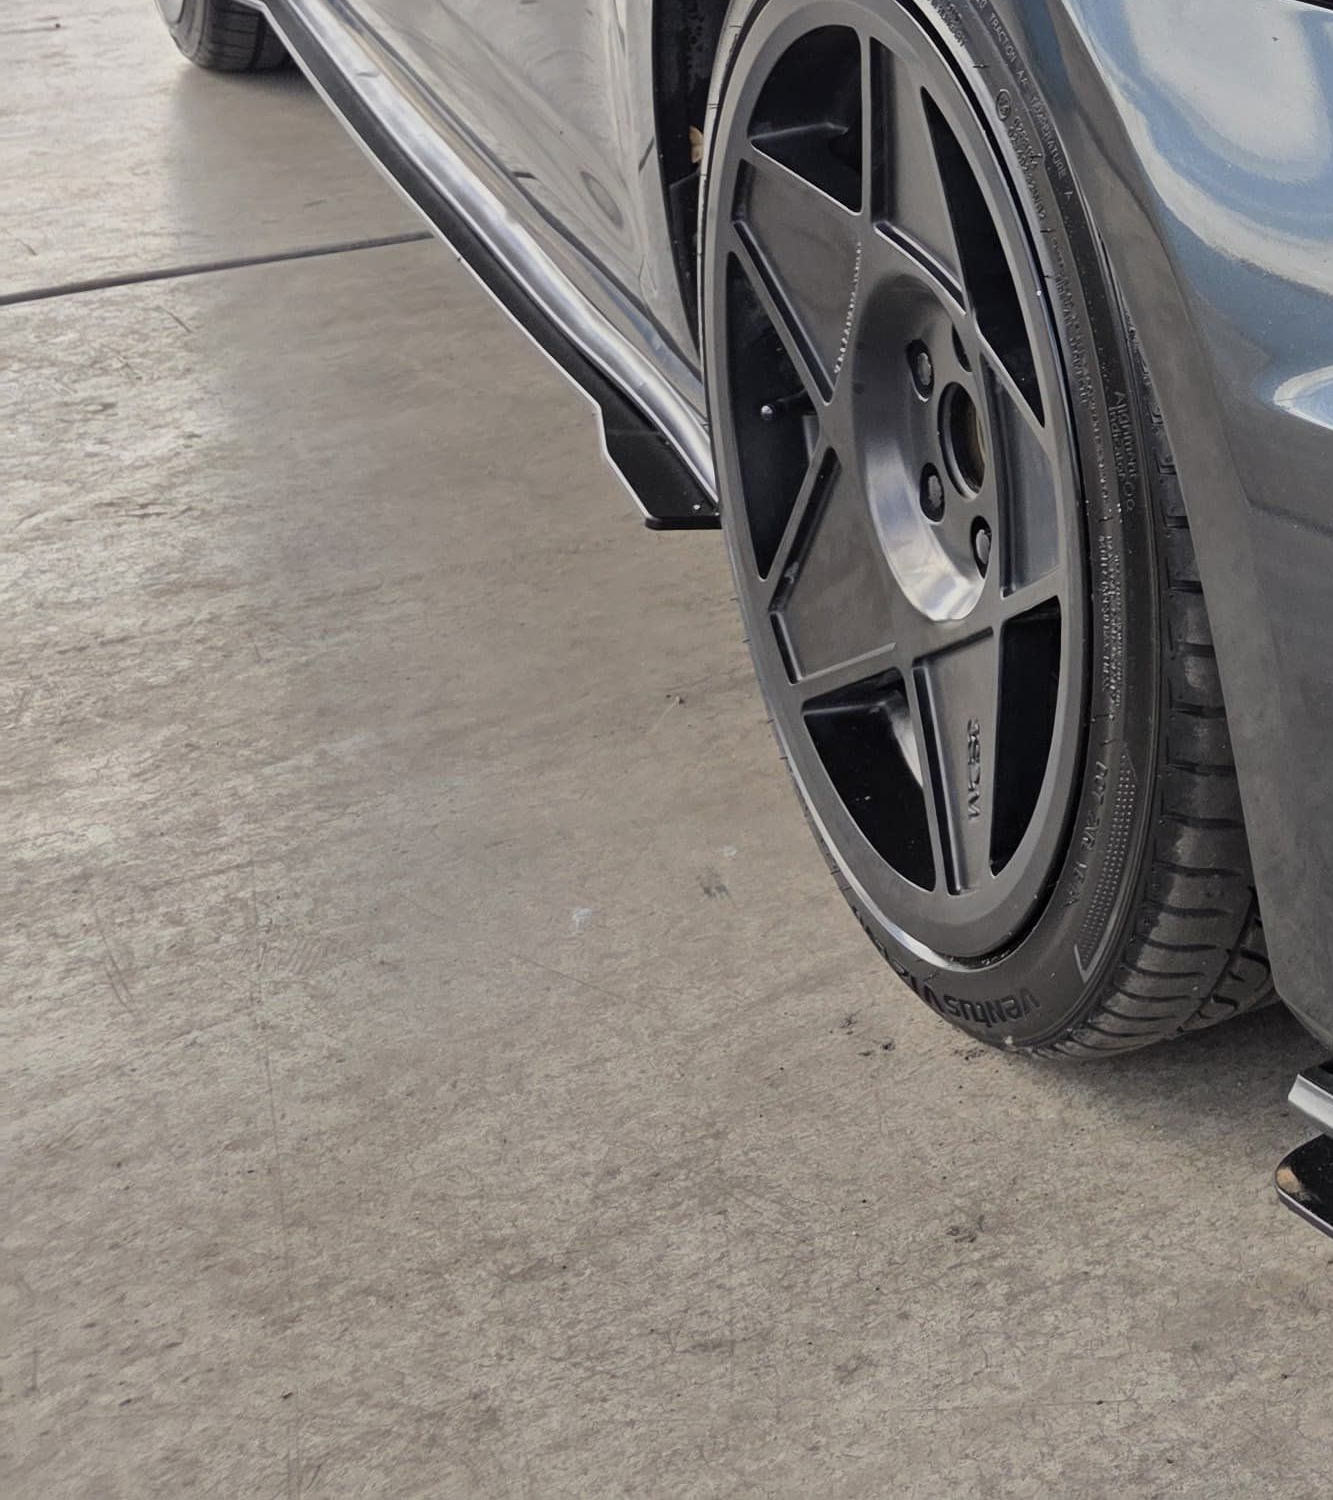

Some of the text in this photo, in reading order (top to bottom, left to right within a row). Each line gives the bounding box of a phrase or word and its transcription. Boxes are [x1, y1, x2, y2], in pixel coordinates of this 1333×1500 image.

[989, 12, 1017, 62] TRACTION
[1108, 406, 1127, 479] Indicator
[1114, 390, 1137, 478] Alignment
